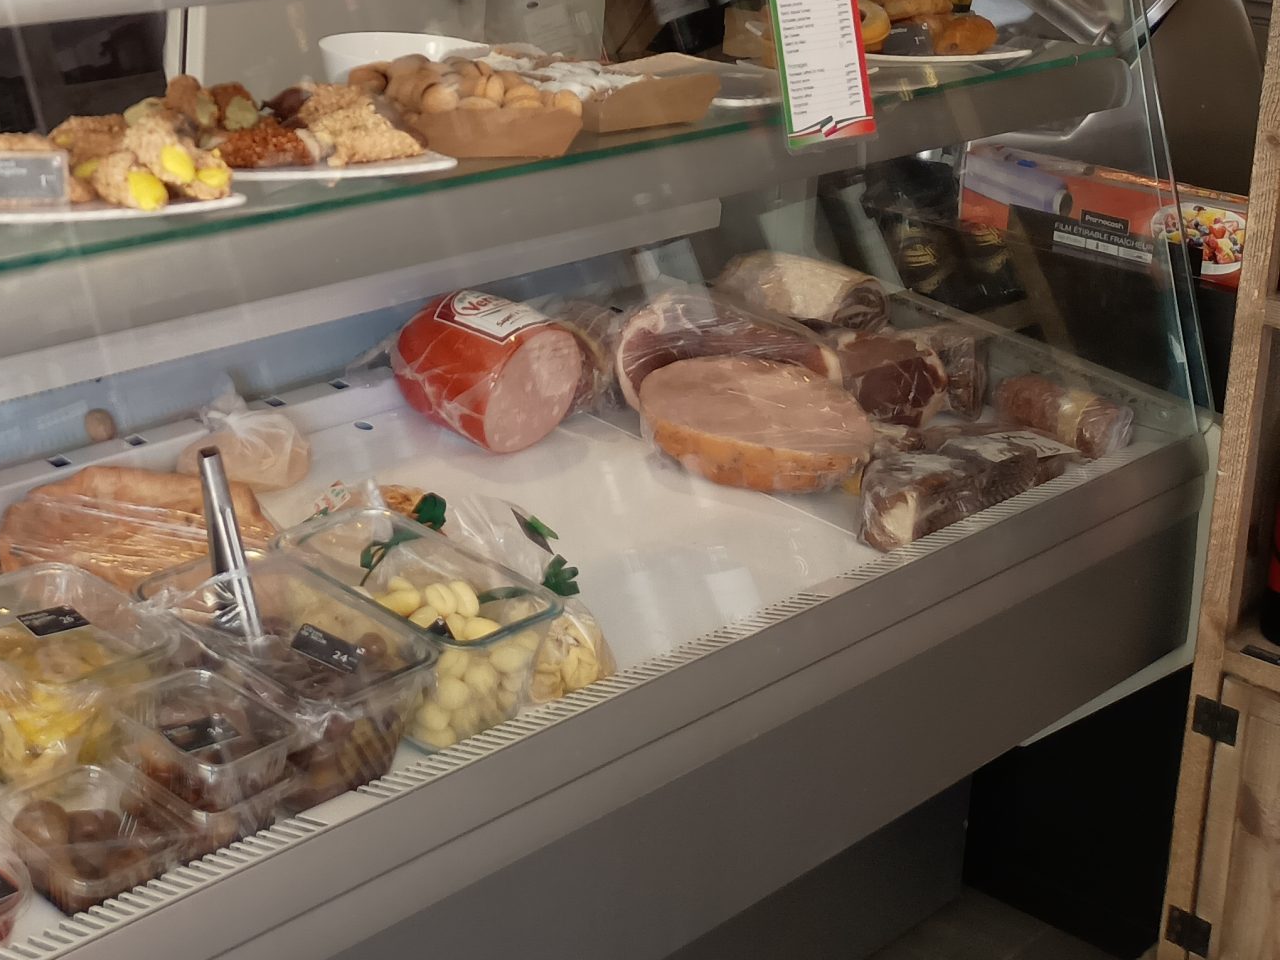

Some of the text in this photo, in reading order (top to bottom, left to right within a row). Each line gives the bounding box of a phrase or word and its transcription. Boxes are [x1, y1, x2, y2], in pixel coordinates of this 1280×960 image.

[1054, 222, 1072, 233] FILM
[1073, 224, 1110, 241] ÉTIRABLE
[332, 650, 349, 663] 24
